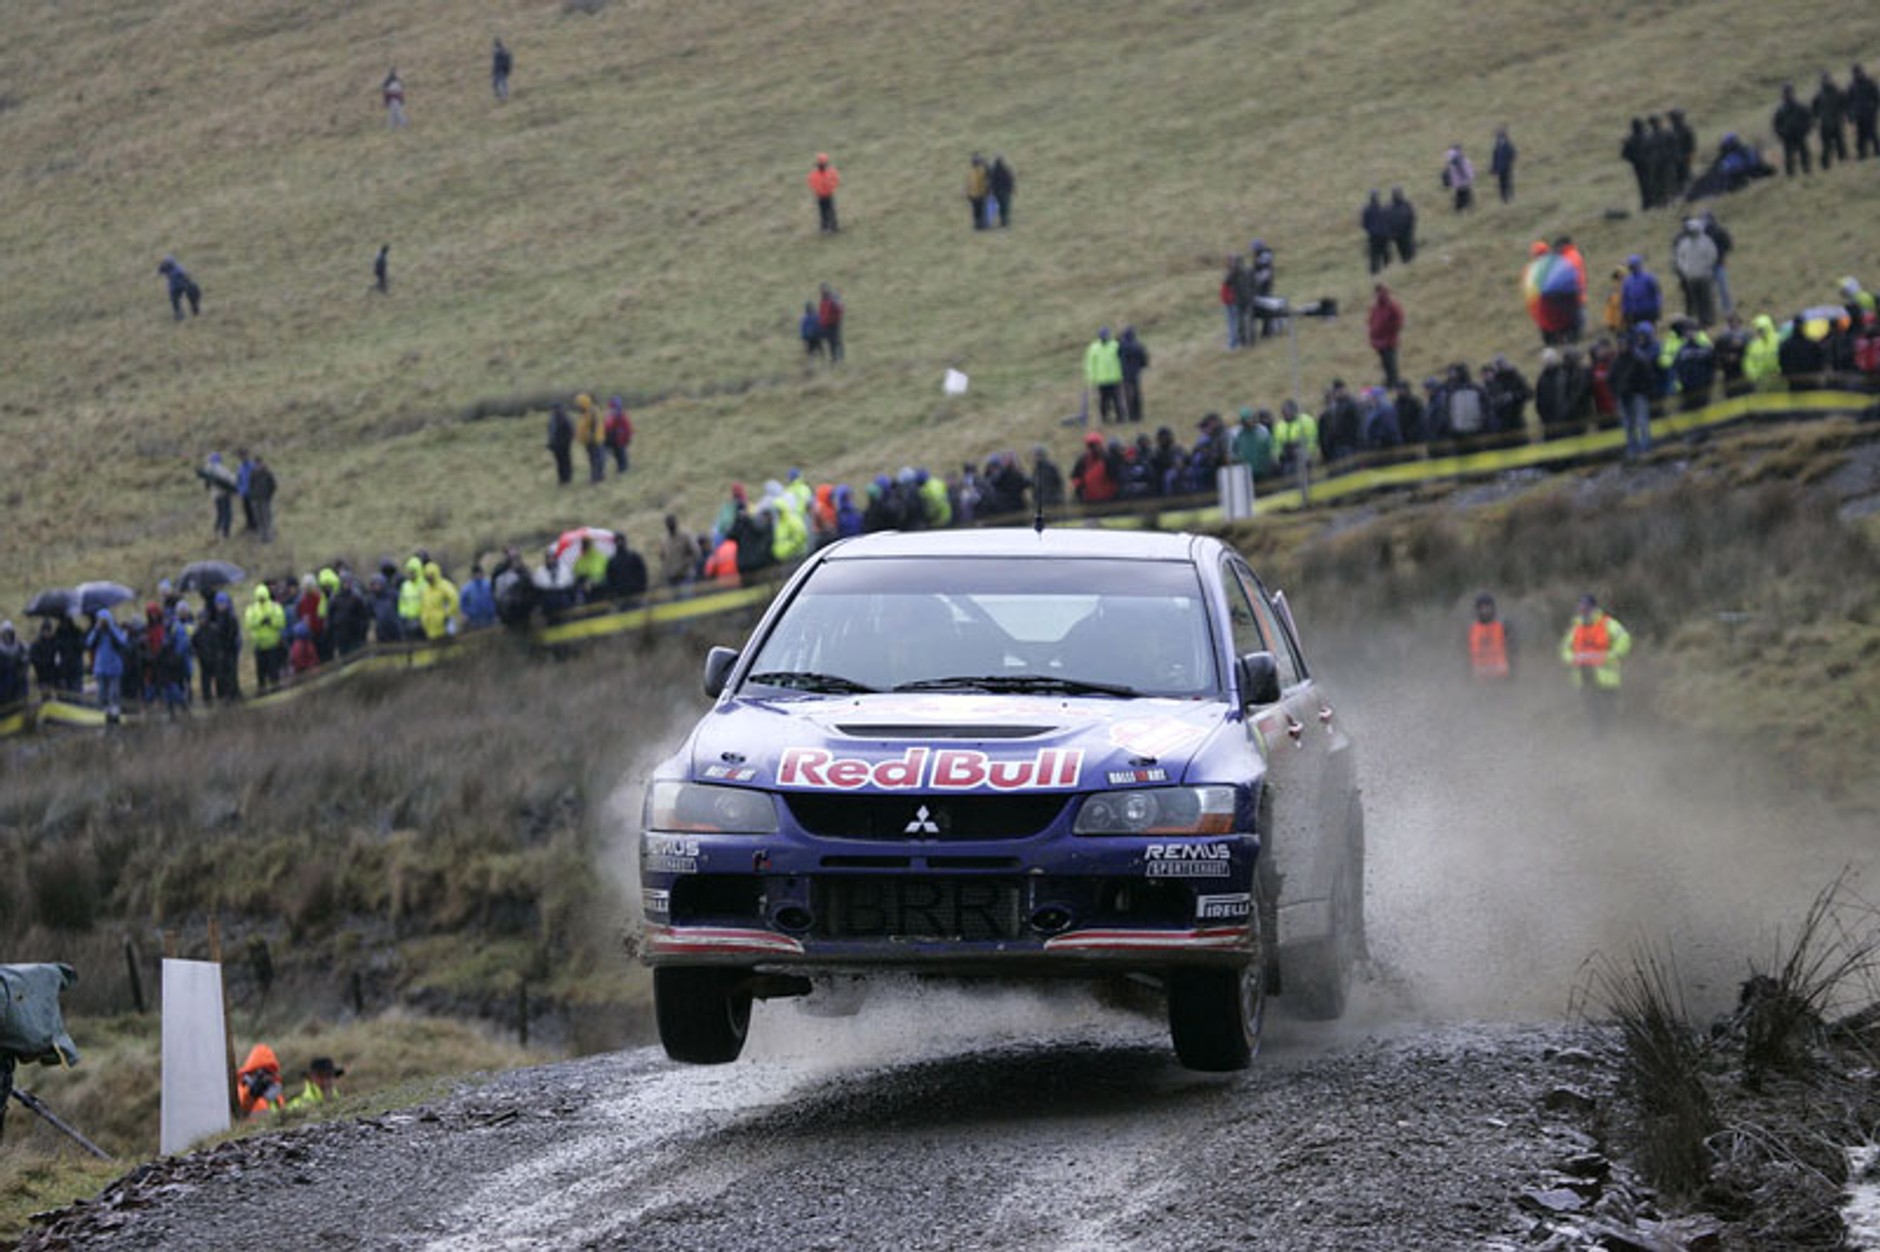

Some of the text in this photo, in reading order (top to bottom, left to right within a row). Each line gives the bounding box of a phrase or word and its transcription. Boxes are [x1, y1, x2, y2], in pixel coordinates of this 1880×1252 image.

[778, 748, 928, 788] Red
[932, 749, 1080, 788] Bull
[1144, 843, 1231, 860] REMUS
[1196, 893, 1250, 918] PIRELLI
